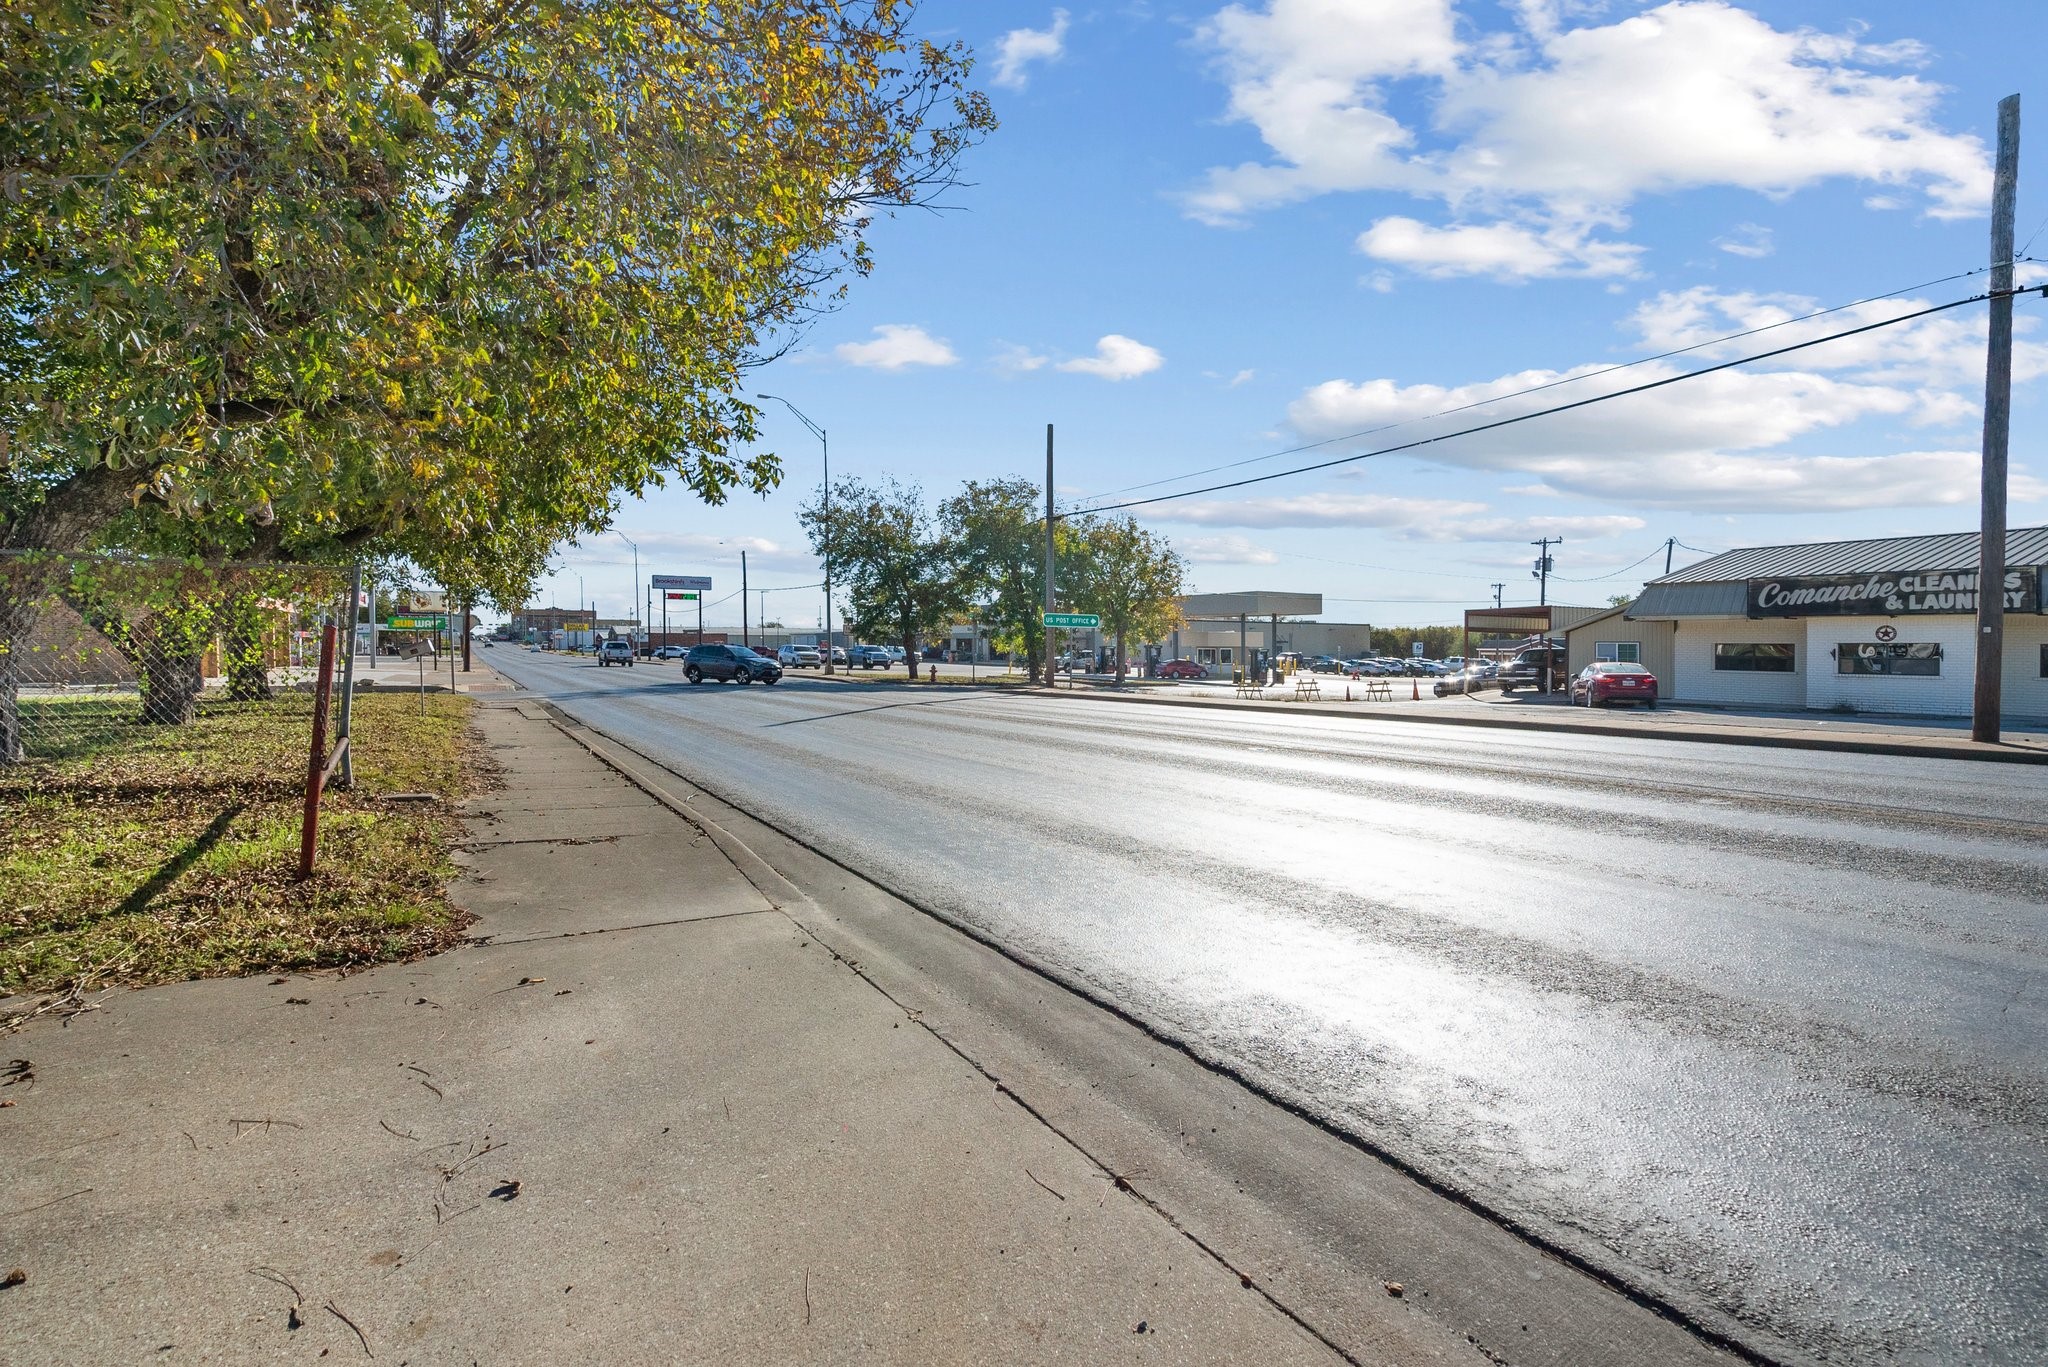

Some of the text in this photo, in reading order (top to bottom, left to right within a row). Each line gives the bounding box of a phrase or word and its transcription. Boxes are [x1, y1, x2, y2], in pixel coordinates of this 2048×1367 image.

[1758, 572, 2022, 608] Comanche CLEANS
[1885, 591, 2027, 610] & LAUNY
